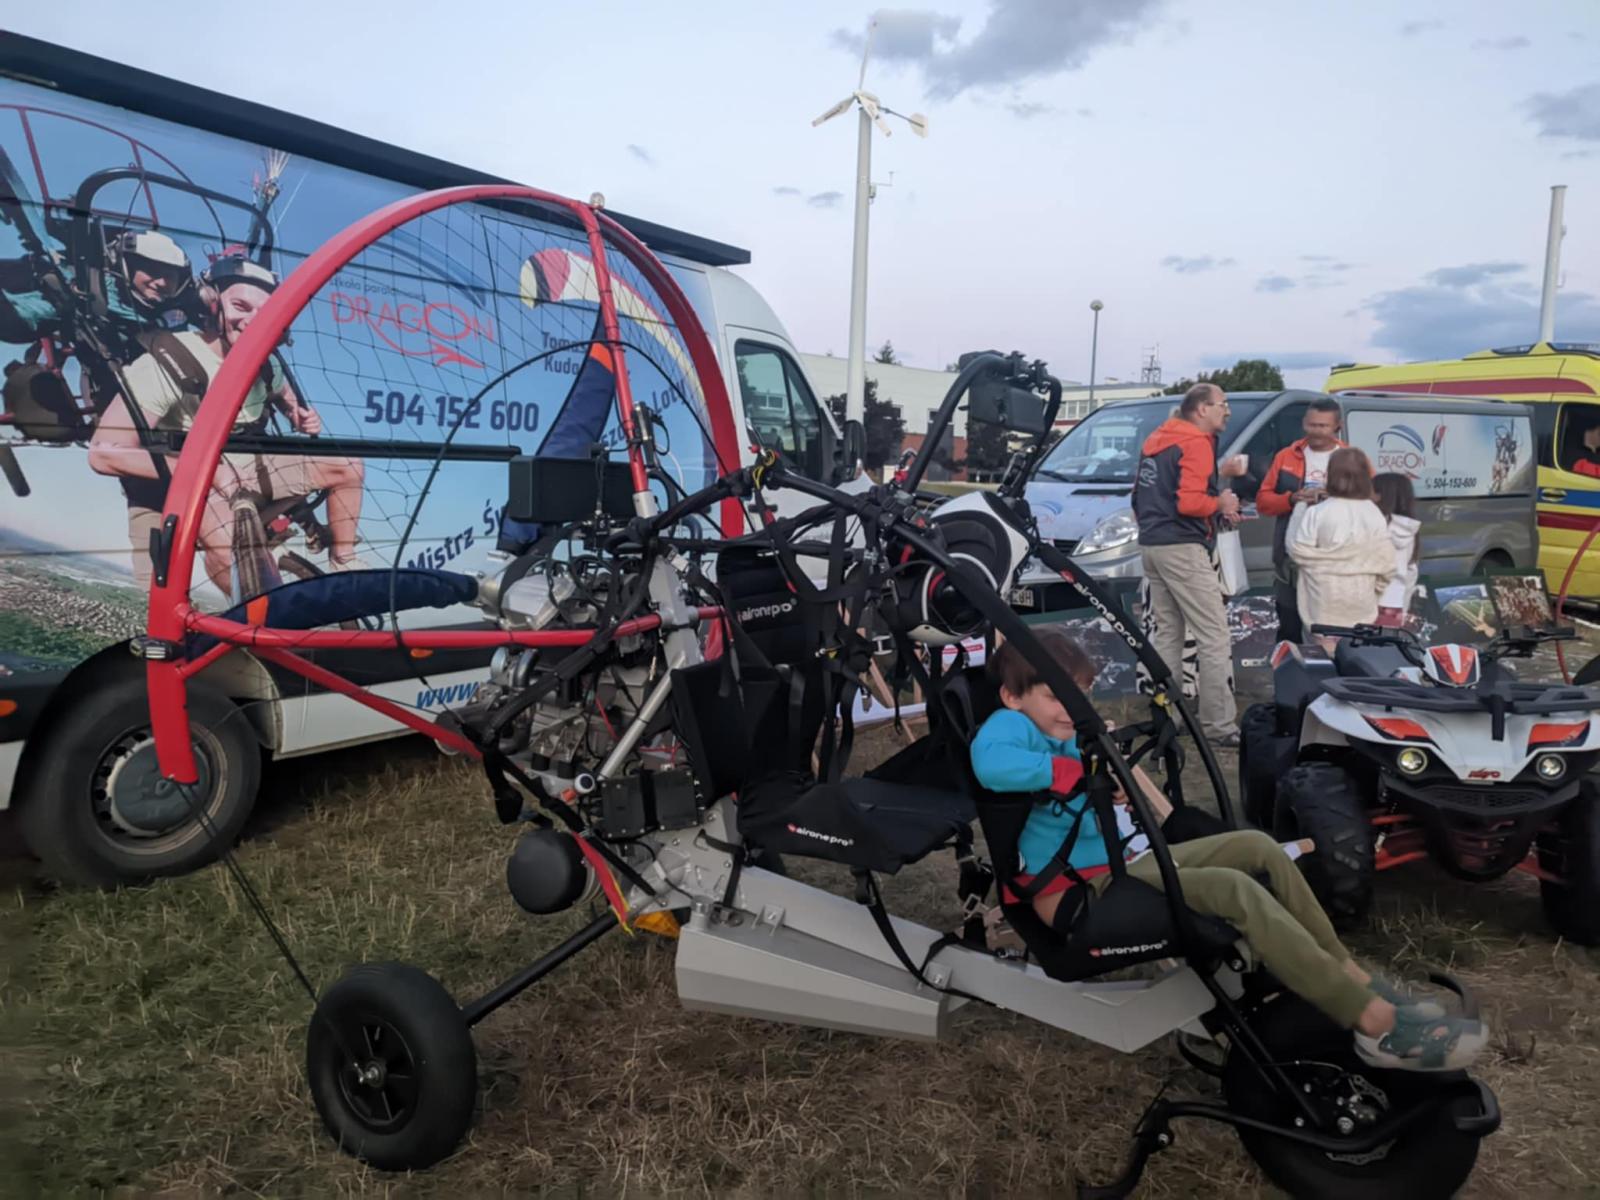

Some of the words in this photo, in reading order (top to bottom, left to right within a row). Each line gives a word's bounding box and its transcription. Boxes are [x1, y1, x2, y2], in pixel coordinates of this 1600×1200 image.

[330, 292, 494, 344] DRAGON
[544, 356, 580, 376] Kuda
[364, 390, 424, 425] 504
[435, 396, 482, 429] 152
[490, 400, 540, 432] 600
[1378, 452, 1426, 469] DRAGON
[407, 526, 474, 570] Mistrz
